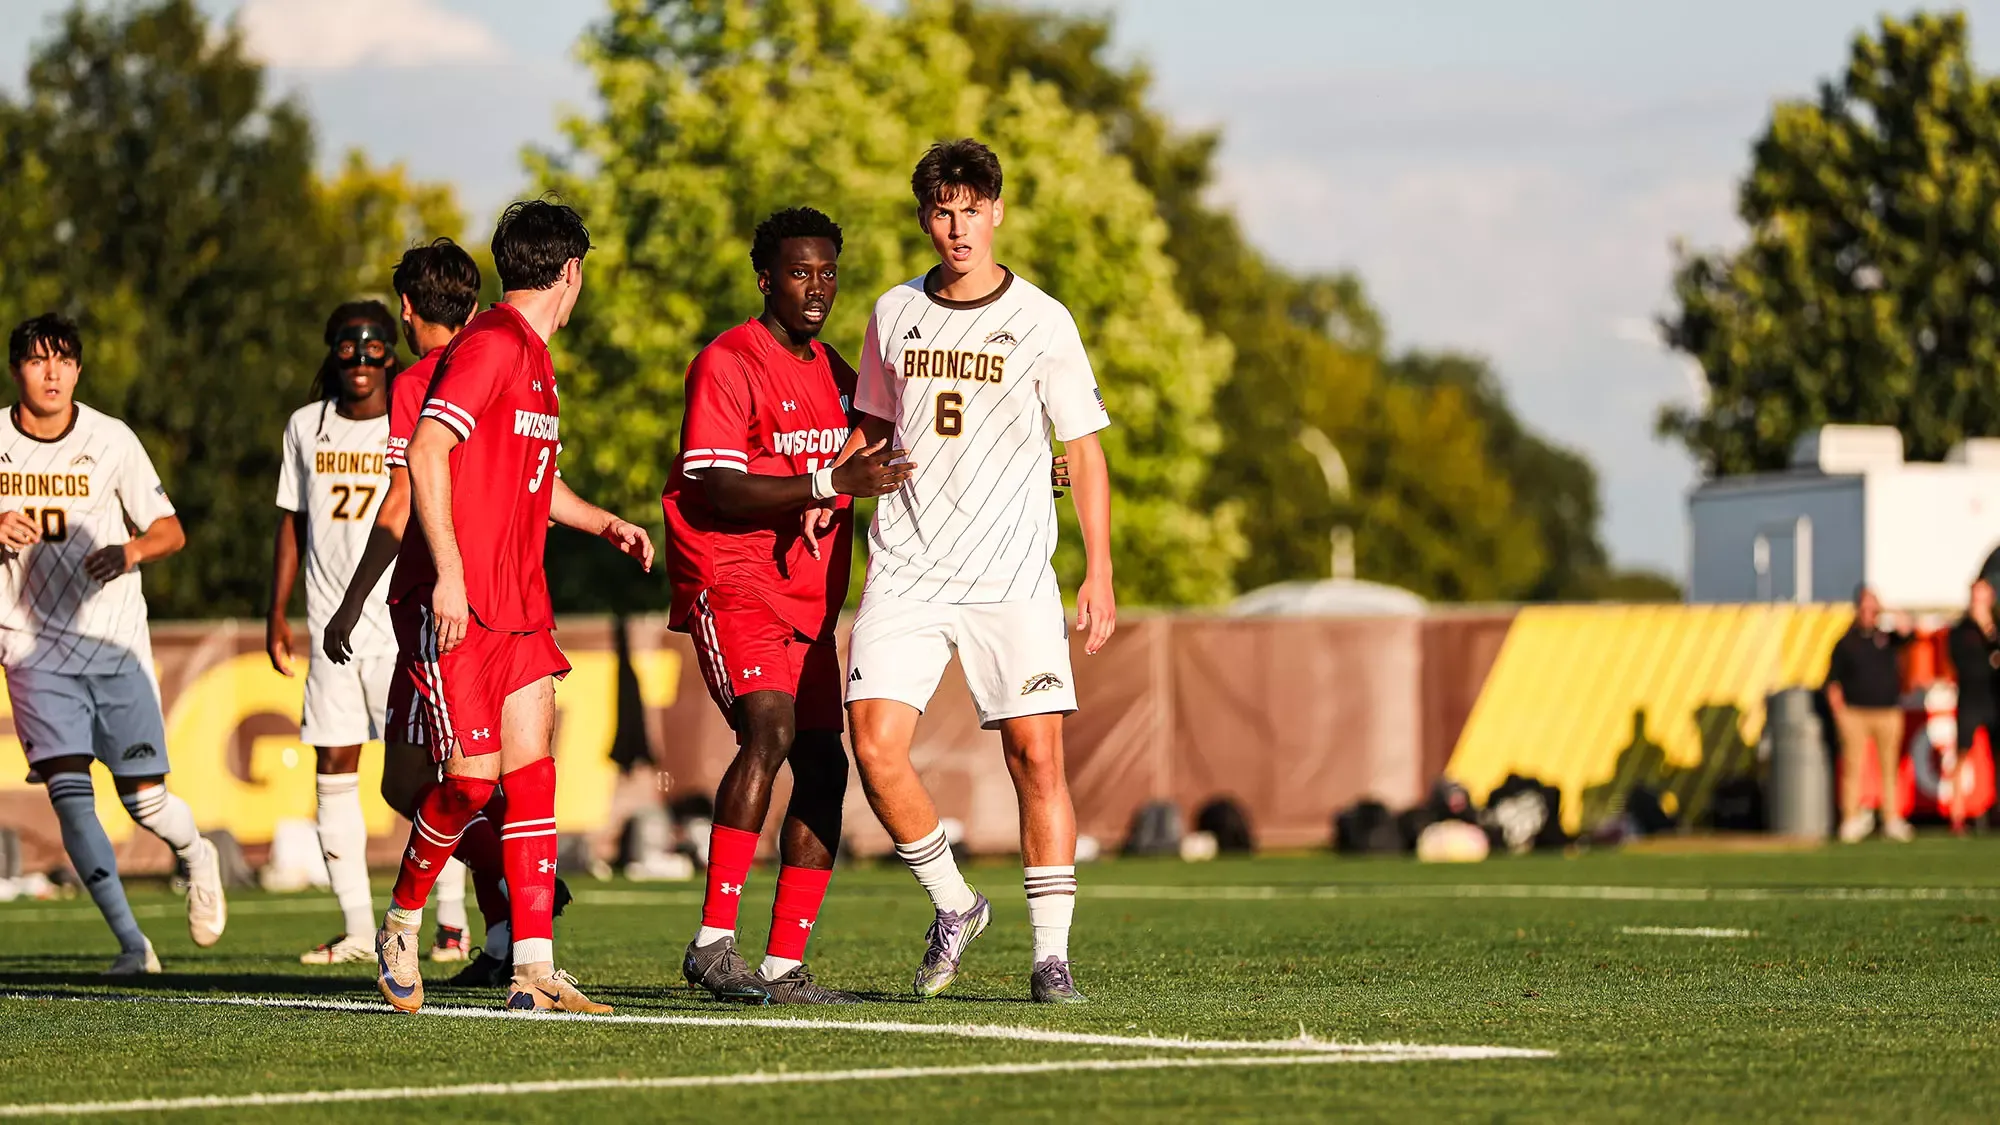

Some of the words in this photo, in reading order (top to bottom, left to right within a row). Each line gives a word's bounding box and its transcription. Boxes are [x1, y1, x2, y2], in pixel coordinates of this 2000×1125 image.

[903, 349, 1005, 383] BRONCOS
[935, 390, 964, 438] 6
[315, 451, 384, 475] BRONCO
[528, 446, 550, 494] 3
[0, 472, 90, 497] BRONCOS
[330, 484, 377, 521] 27
